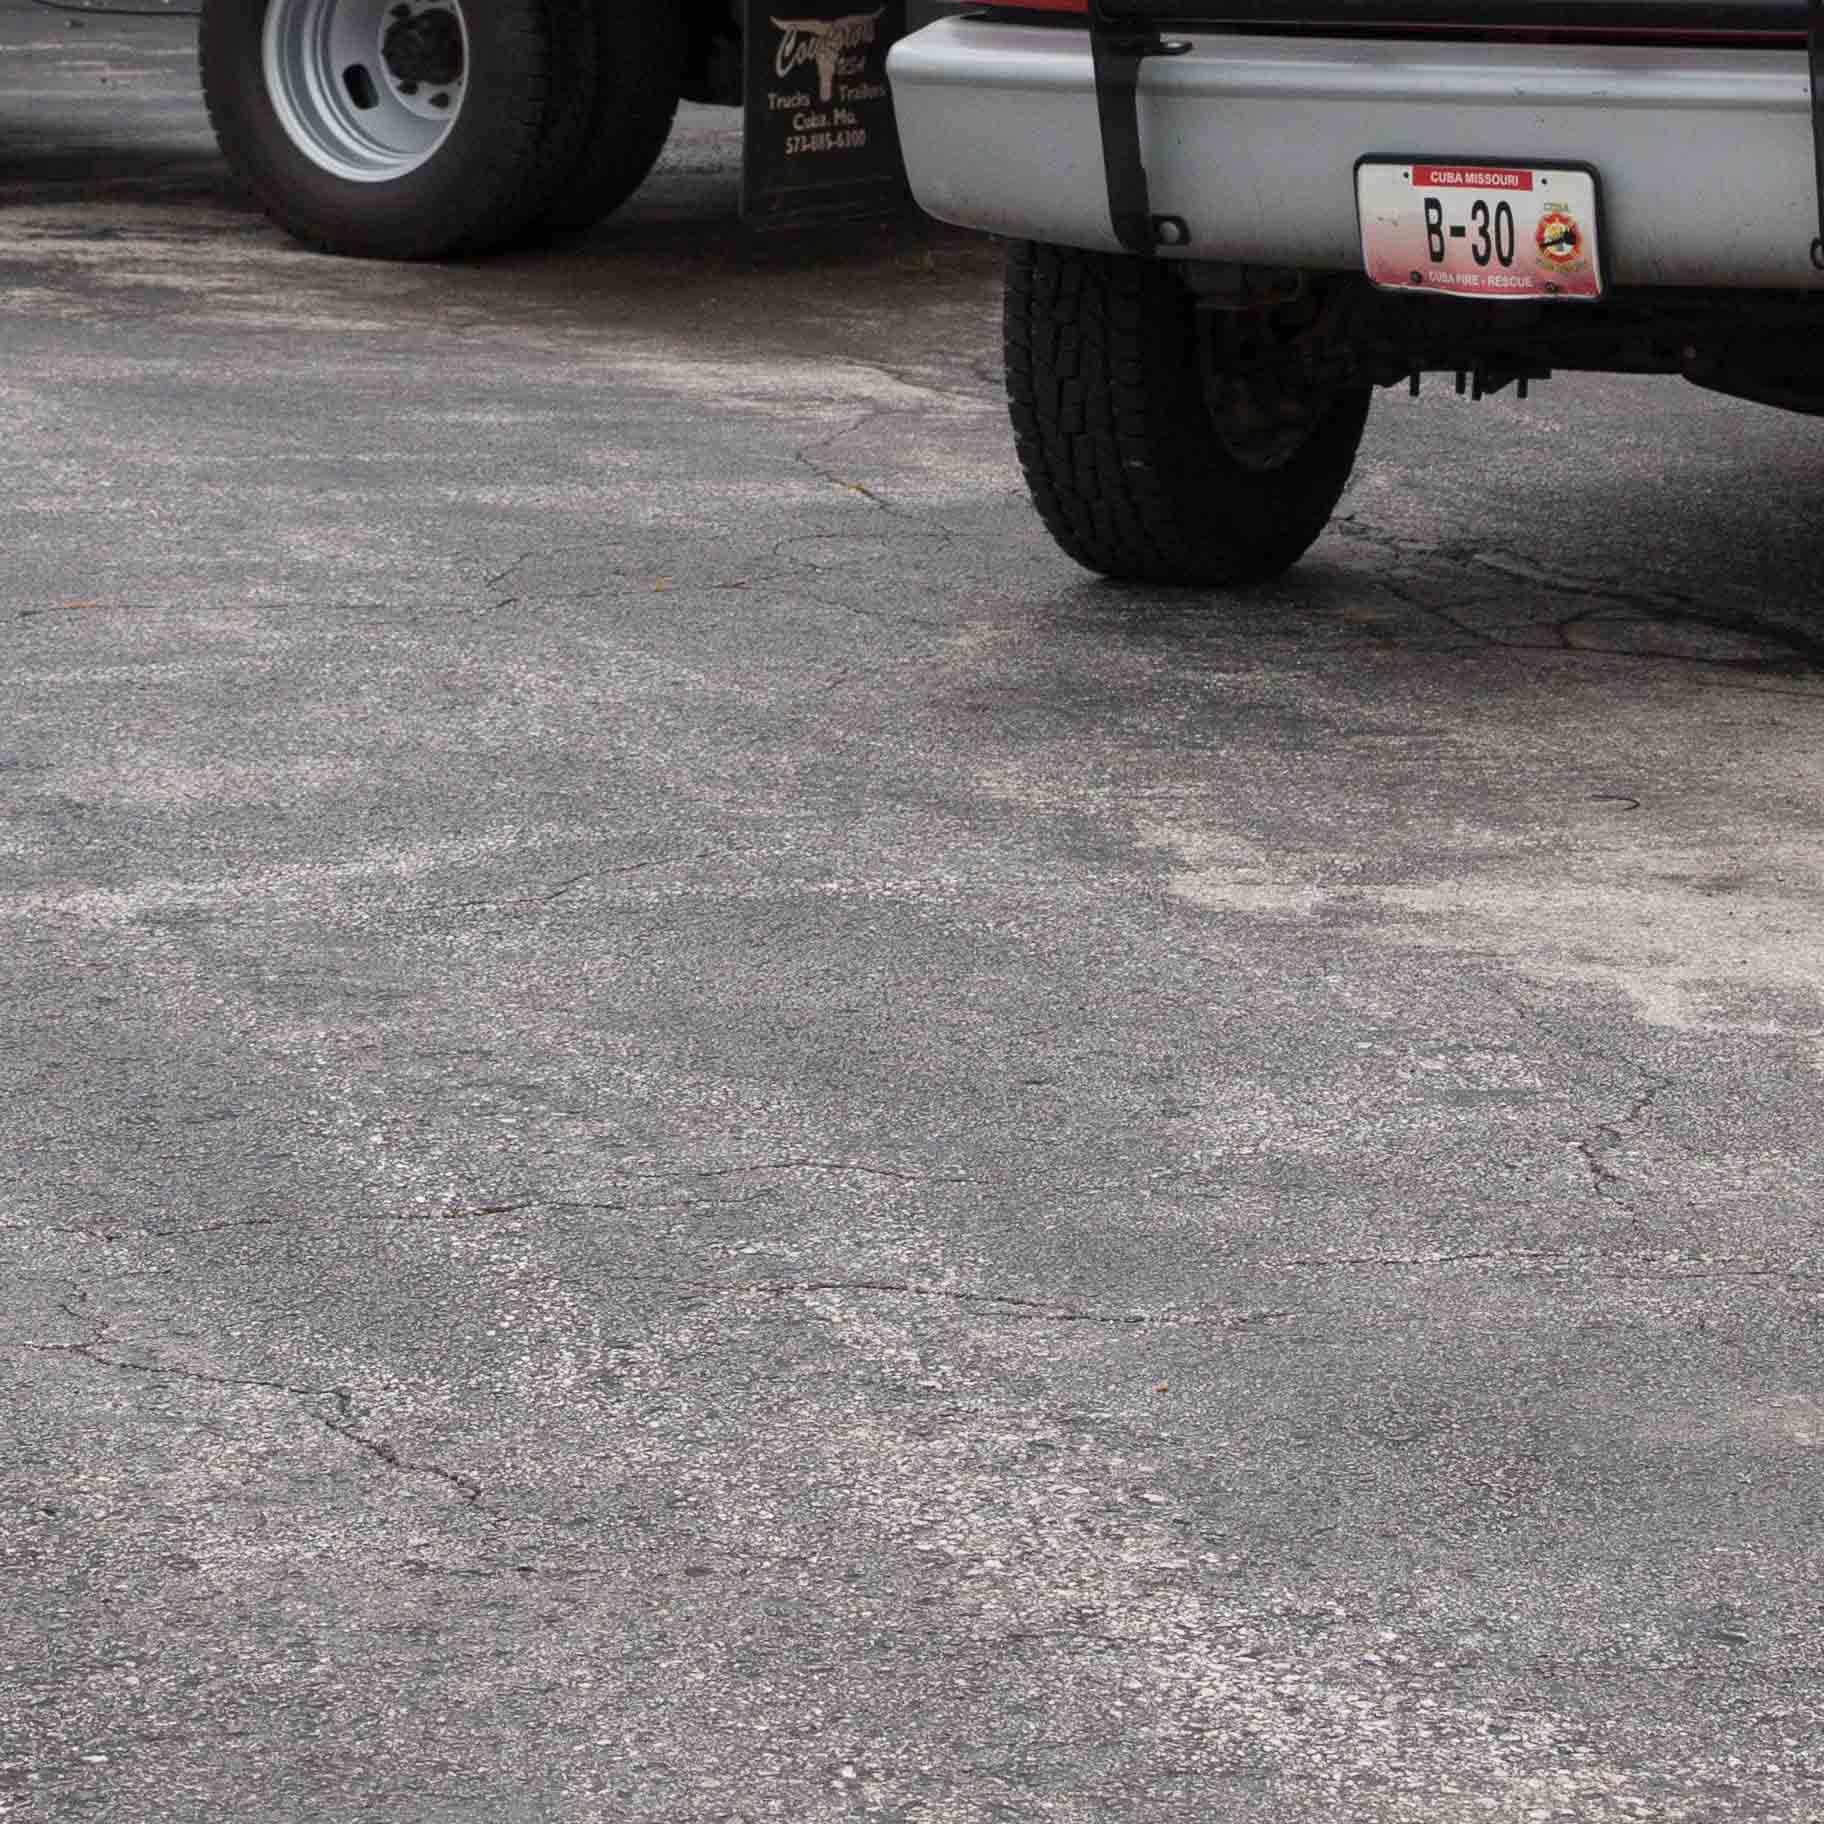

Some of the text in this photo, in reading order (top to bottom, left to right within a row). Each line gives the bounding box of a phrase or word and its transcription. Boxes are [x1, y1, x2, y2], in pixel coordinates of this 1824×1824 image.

[767, 90, 811, 110] Trucks
[1430, 171, 1519, 186] CUBA MISSOURI
[1424, 197, 1515, 267] B-30
[1428, 271, 1456, 284] CUBA
[1456, 273, 1480, 286] FIRE
[1487, 274, 1535, 288] RESCUE
